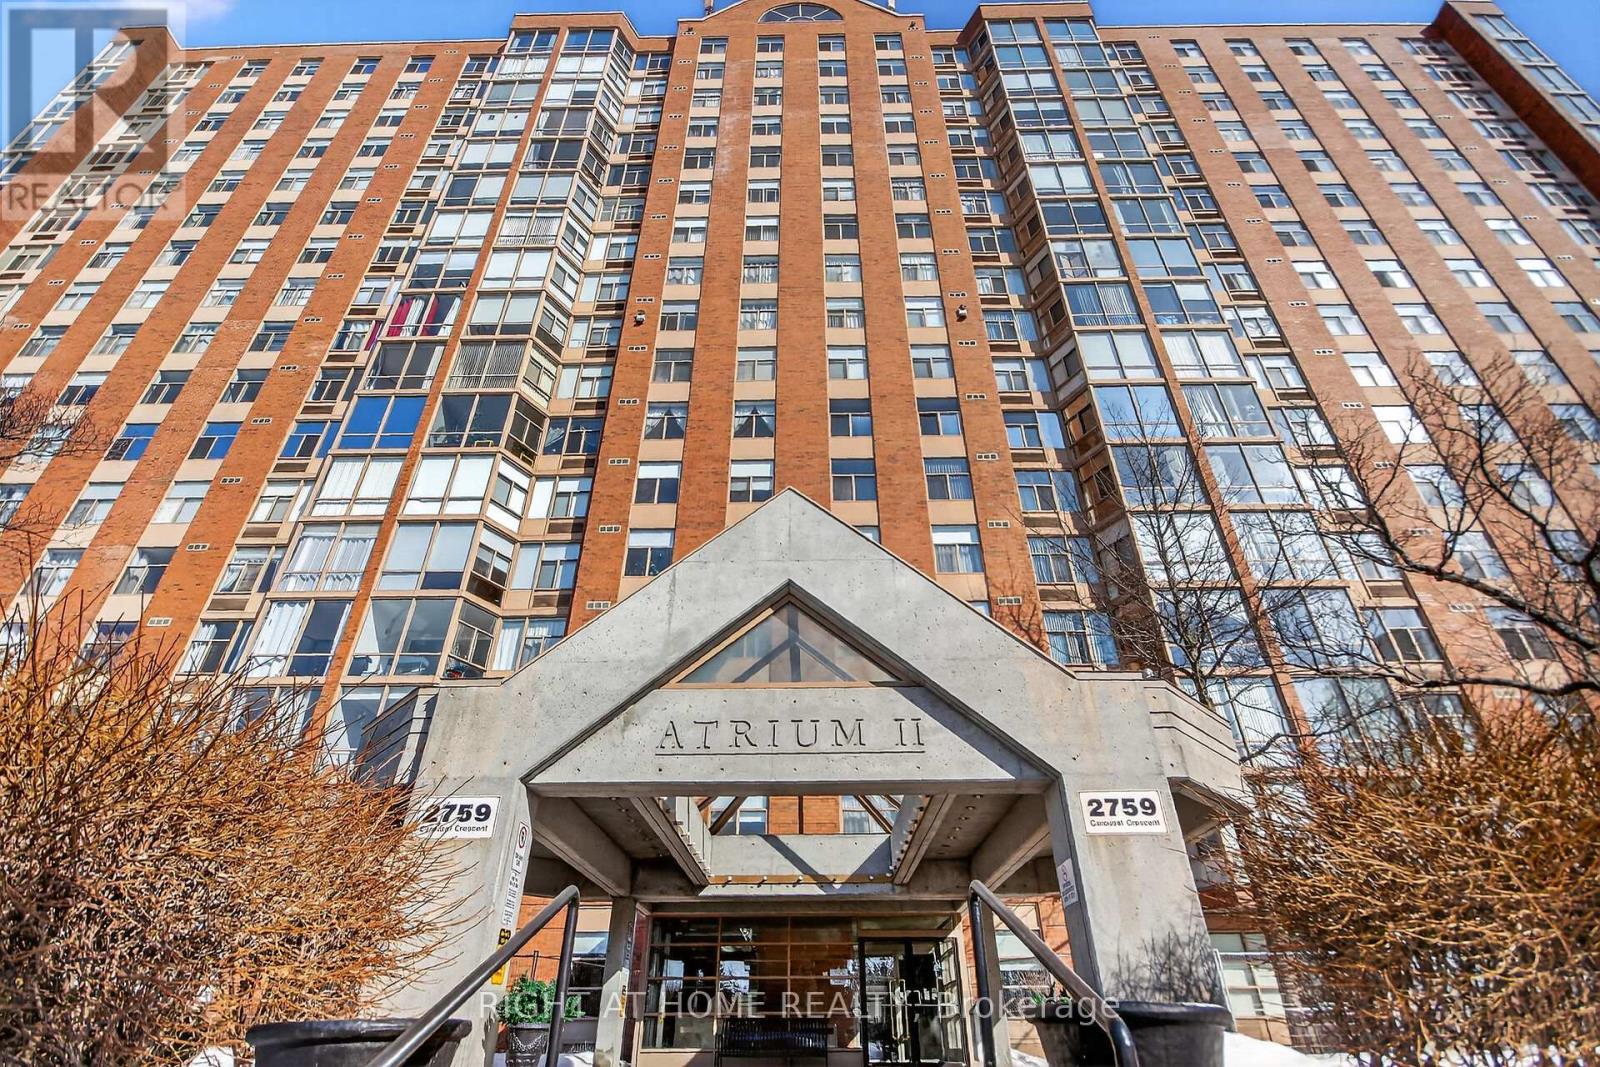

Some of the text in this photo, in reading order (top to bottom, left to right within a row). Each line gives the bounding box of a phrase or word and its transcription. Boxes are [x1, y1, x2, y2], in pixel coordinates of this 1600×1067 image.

[655, 718, 925, 749] ATRIUM II
[421, 803, 492, 823] 2759
[1087, 797, 1157, 817] 2759
[454, 824, 489, 832] Crescent
